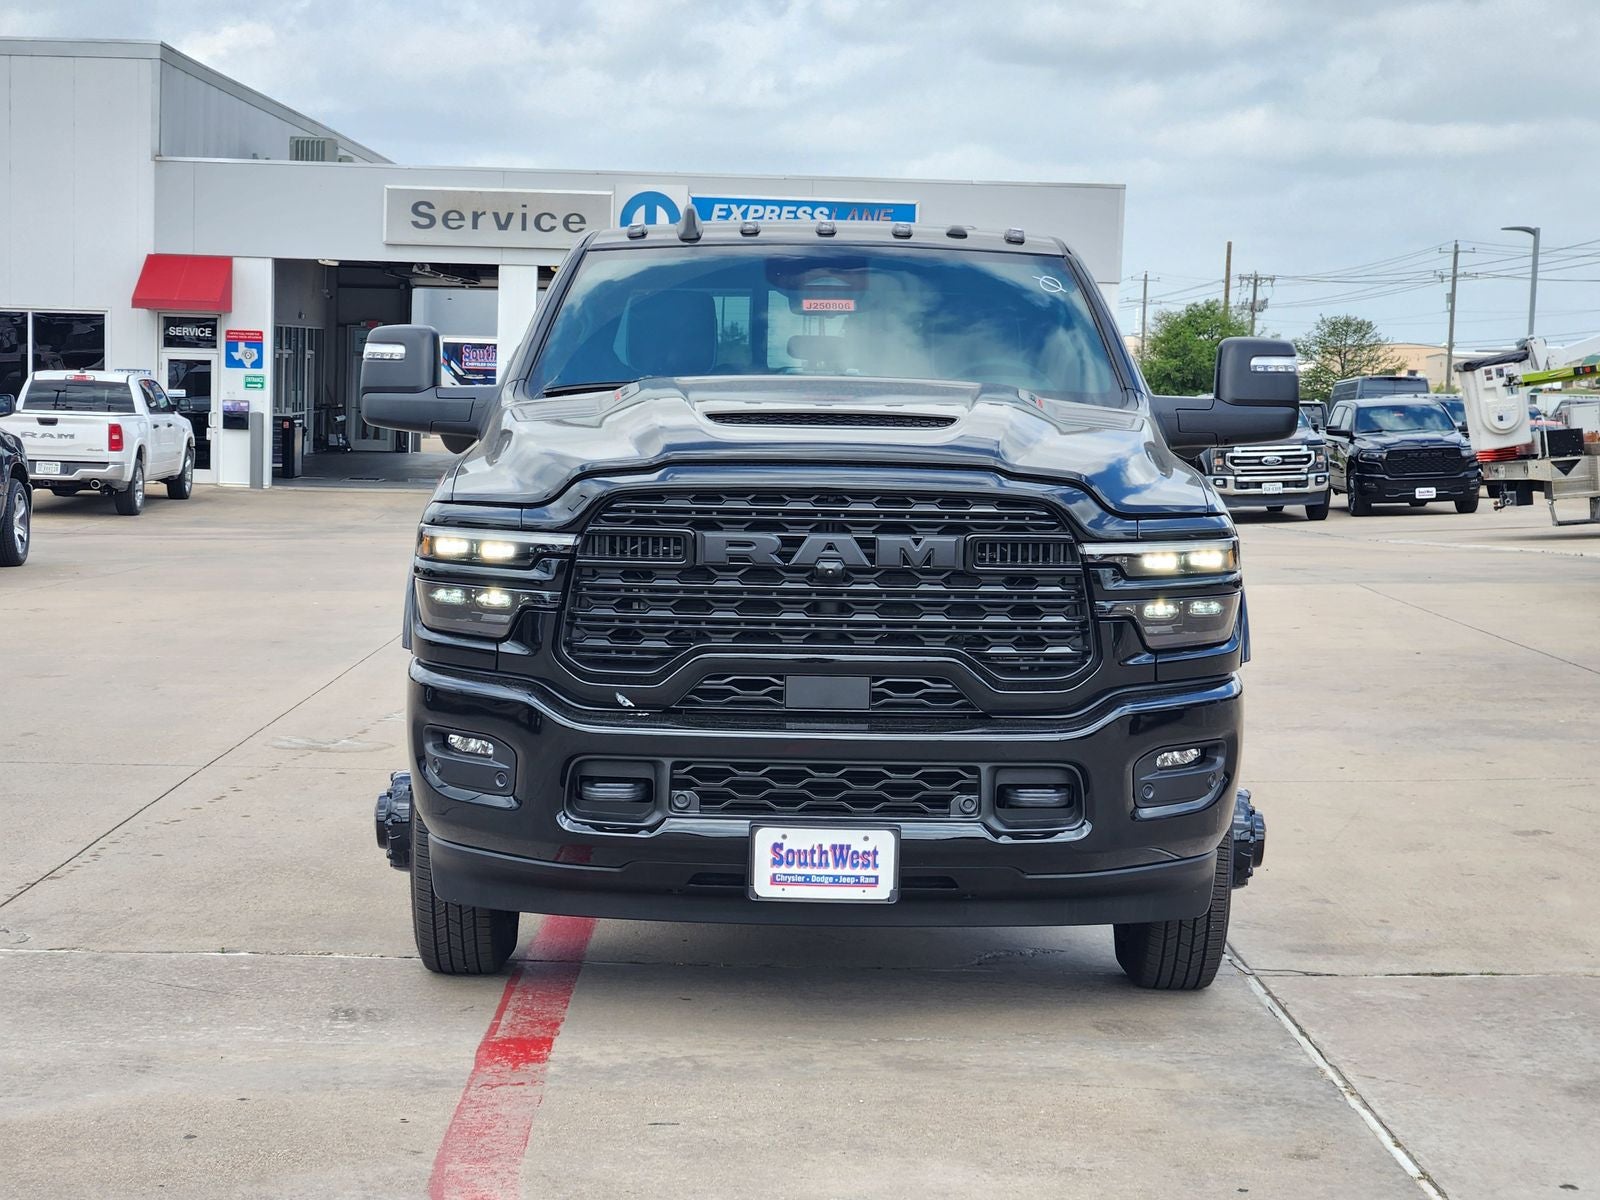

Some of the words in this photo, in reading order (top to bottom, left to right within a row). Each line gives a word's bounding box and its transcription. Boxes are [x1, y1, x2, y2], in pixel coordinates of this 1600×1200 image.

[410, 200, 587, 233] Service
[710, 203, 830, 222] EXPRESS
[830, 206, 894, 222] LANE
[168, 326, 213, 337] SERVICE
[20, 431, 76, 440] RAM
[700, 531, 959, 569] RAM
[770, 842, 879, 870] SouthWest
[775, 874, 806, 883] Chrysler
[811, 874, 834, 884] Dodge
[838, 876, 856, 885] Jeep
[859, 876, 876, 884] Ram
